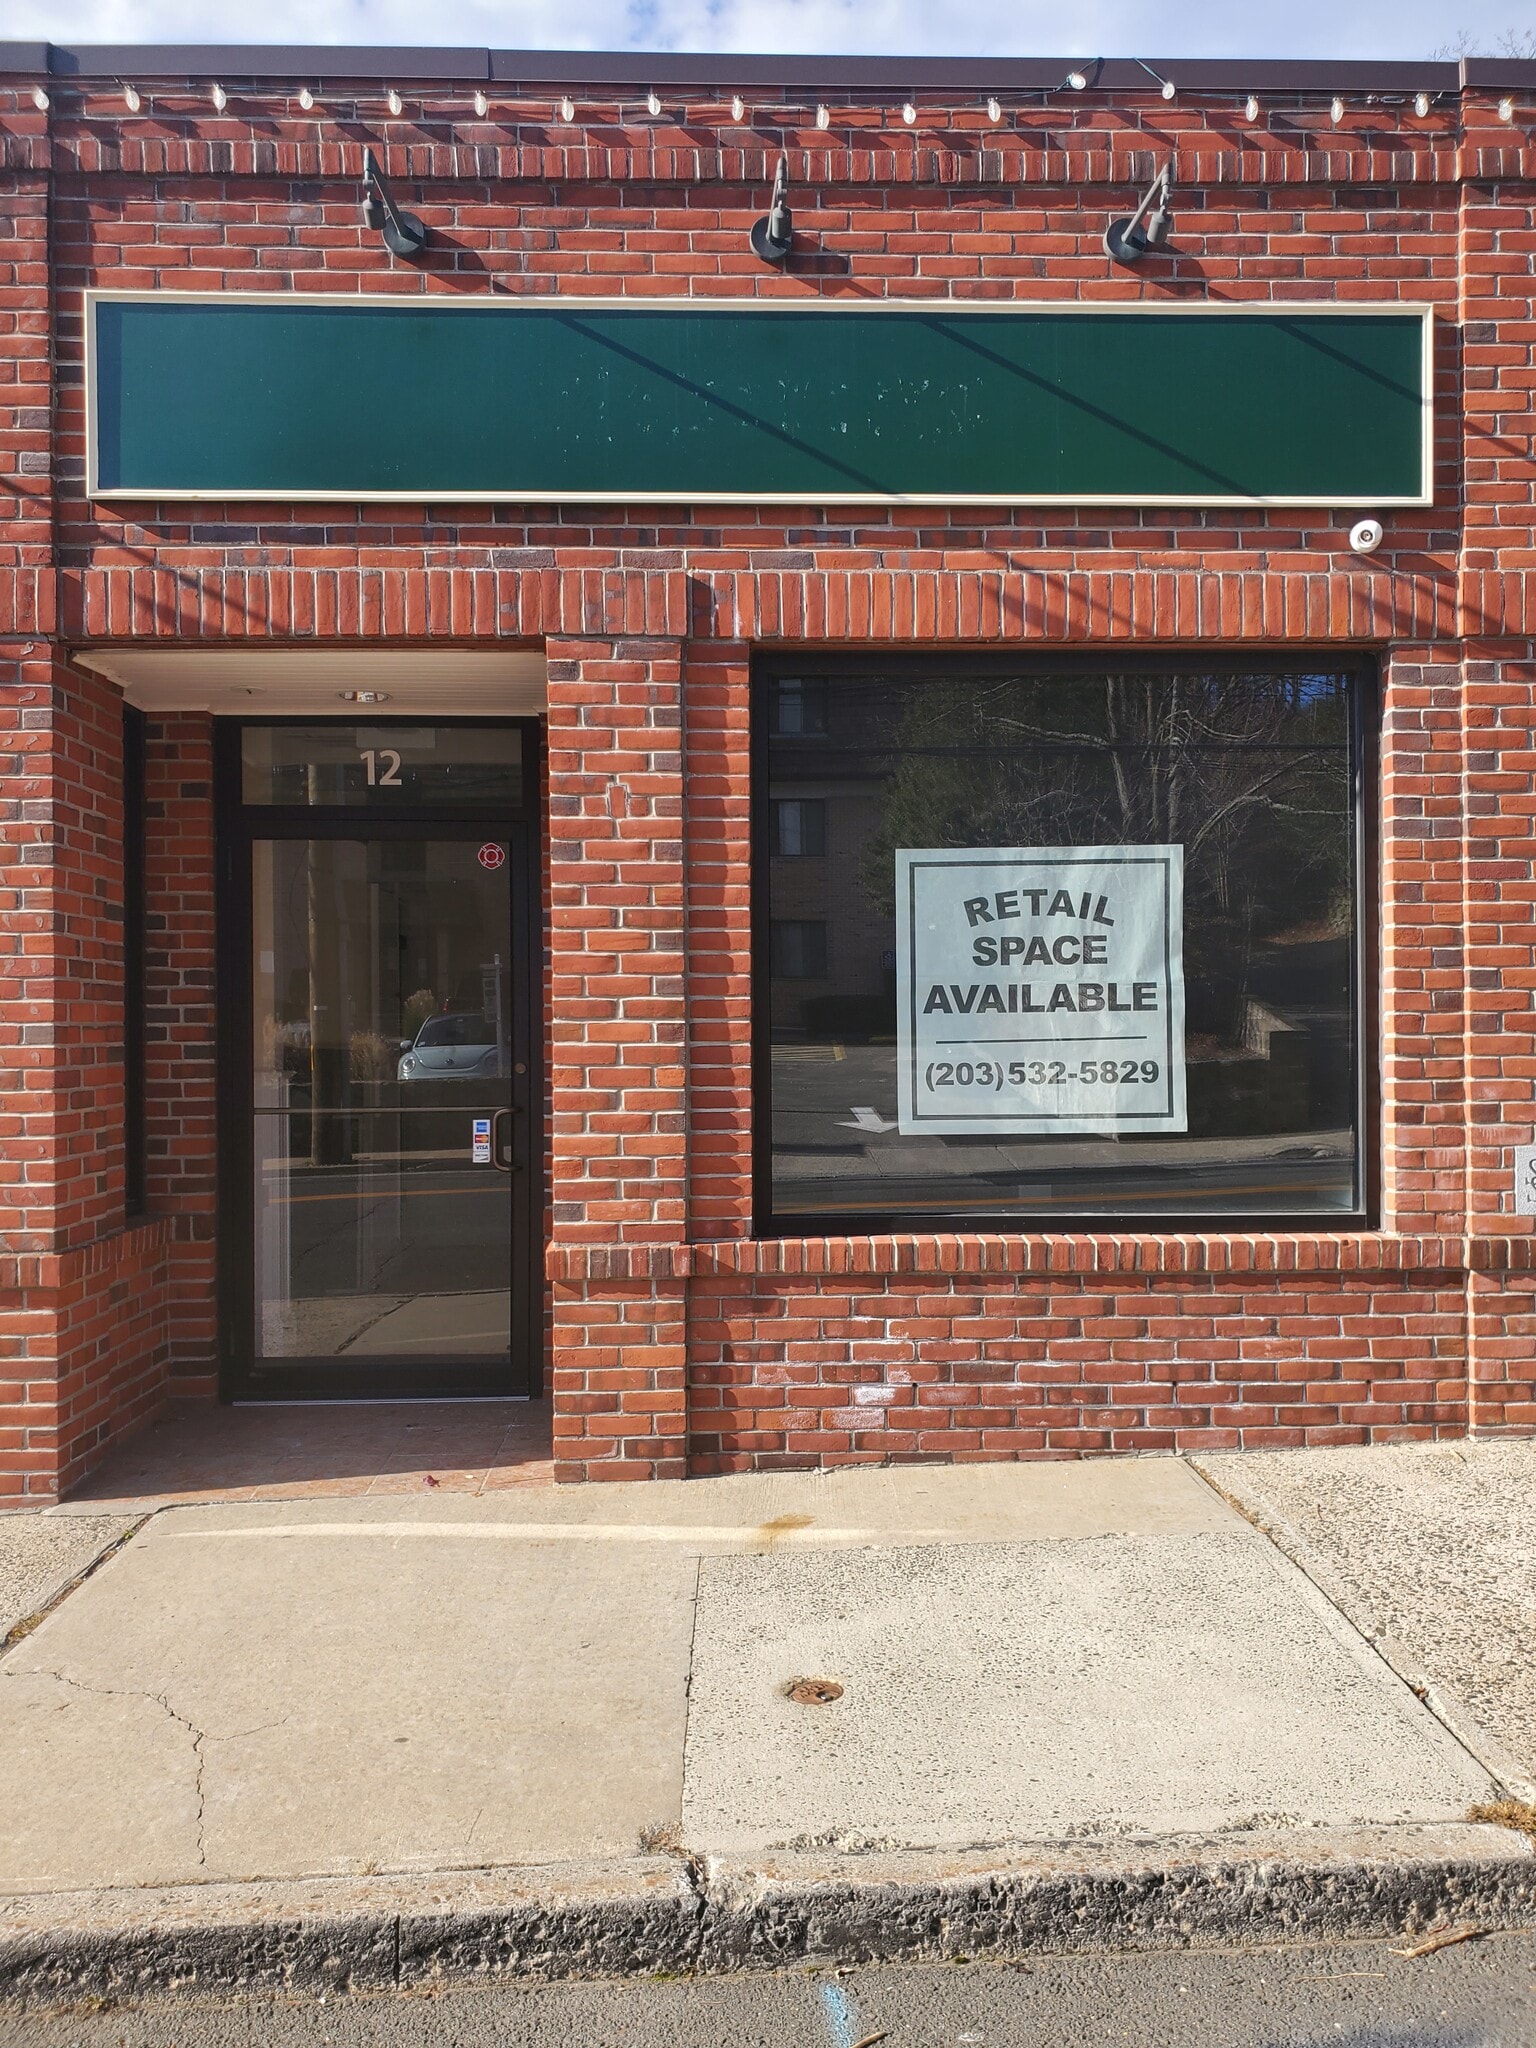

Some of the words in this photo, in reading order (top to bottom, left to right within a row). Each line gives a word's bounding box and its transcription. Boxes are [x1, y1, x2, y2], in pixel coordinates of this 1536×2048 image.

[360, 750, 402, 786] 12
[963, 889, 1115, 927] RETAIL
[972, 935, 1108, 966] SPACE
[923, 982, 1158, 1014] AVAILABLE
